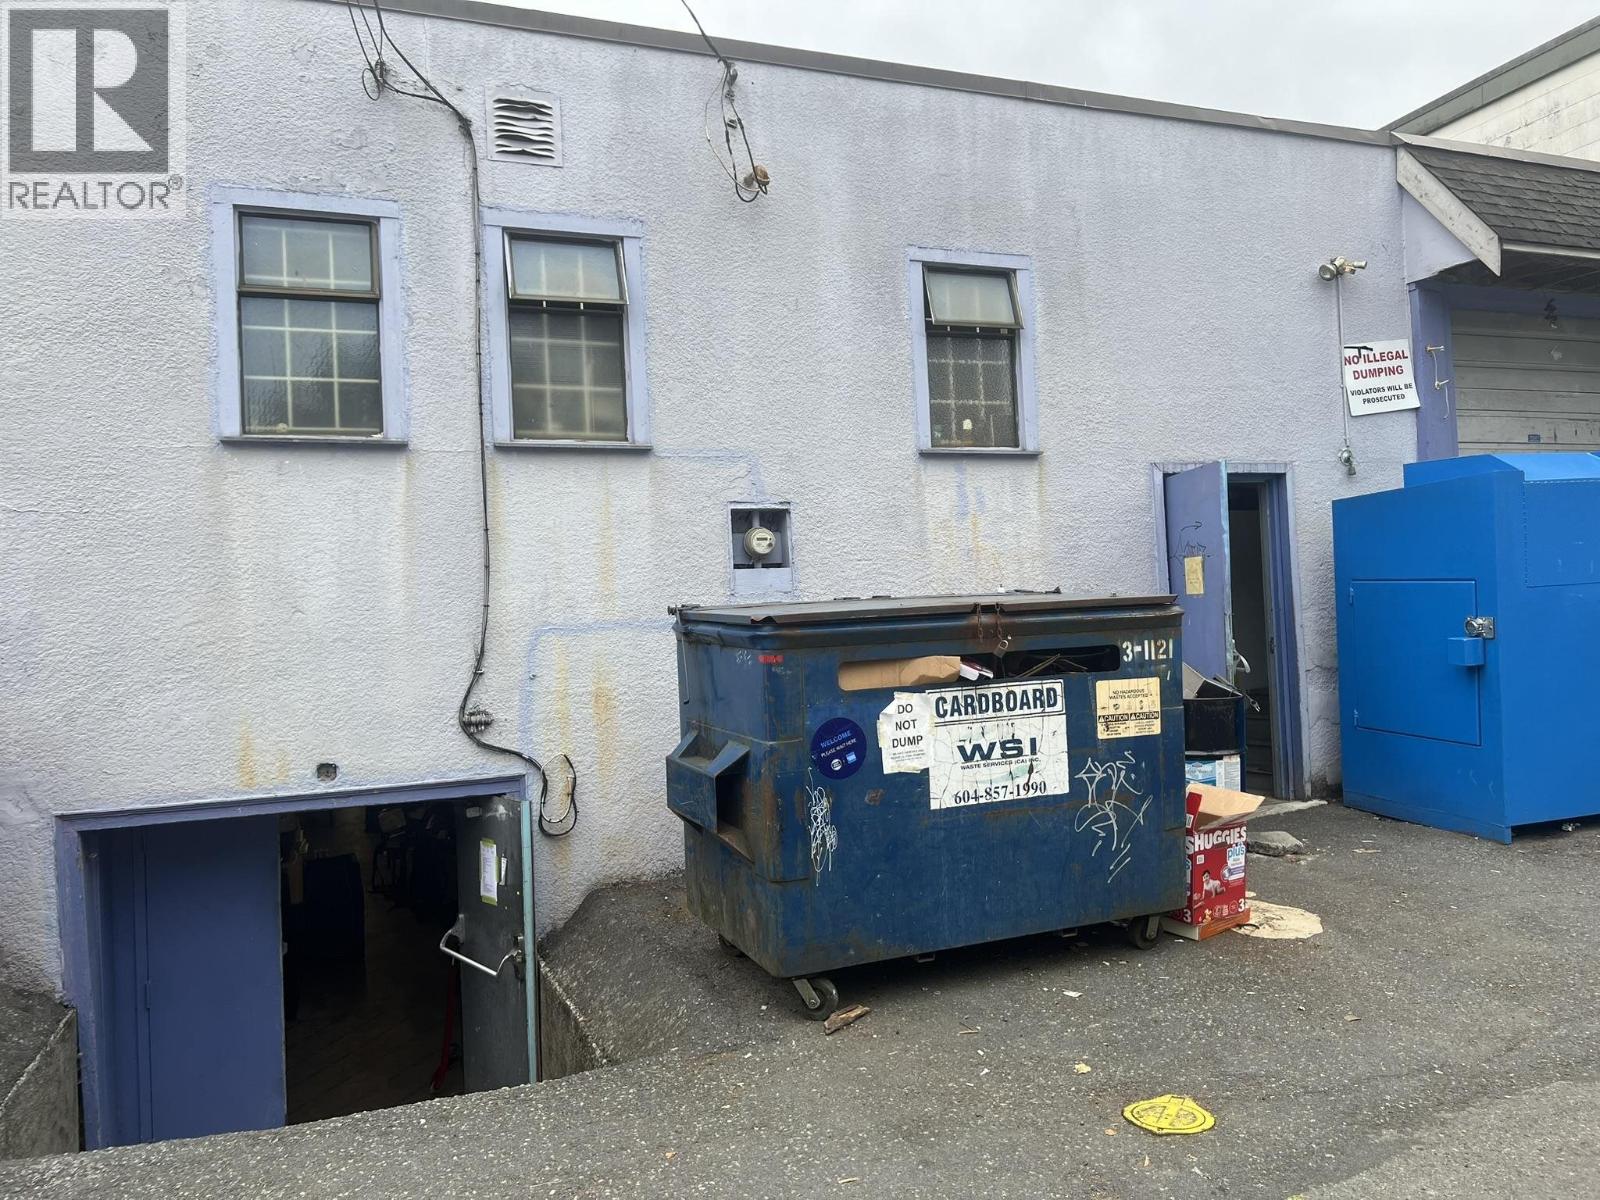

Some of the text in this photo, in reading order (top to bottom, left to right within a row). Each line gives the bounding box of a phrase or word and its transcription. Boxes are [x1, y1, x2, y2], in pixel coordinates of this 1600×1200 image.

[1344, 350, 1409, 366] NO ILLEGAL
[1353, 365, 1404, 380] DUMPING
[1350, 386, 1386, 396] VIOLATORS
[1387, 384, 1403, 392] WILL
[1362, 394, 1406, 405] PROSECUTED
[1122, 638, 1173, 662] 3-1121
[898, 703, 913, 715] DO
[935, 687, 1057, 719] CARDBOARD
[1104, 711, 1159, 722] CAUTION CAUTION
[895, 719, 918, 731] NOT
[820, 730, 851, 748] WELCOME
[892, 735, 923, 749] DUMP
[957, 737, 1038, 762] WSI
[983, 760, 1013, 768] SERVICES
[954, 780, 1047, 805] 604-857-1990
[1194, 826, 1247, 852] HUGGIES
[1238, 899, 1245, 912] 3
